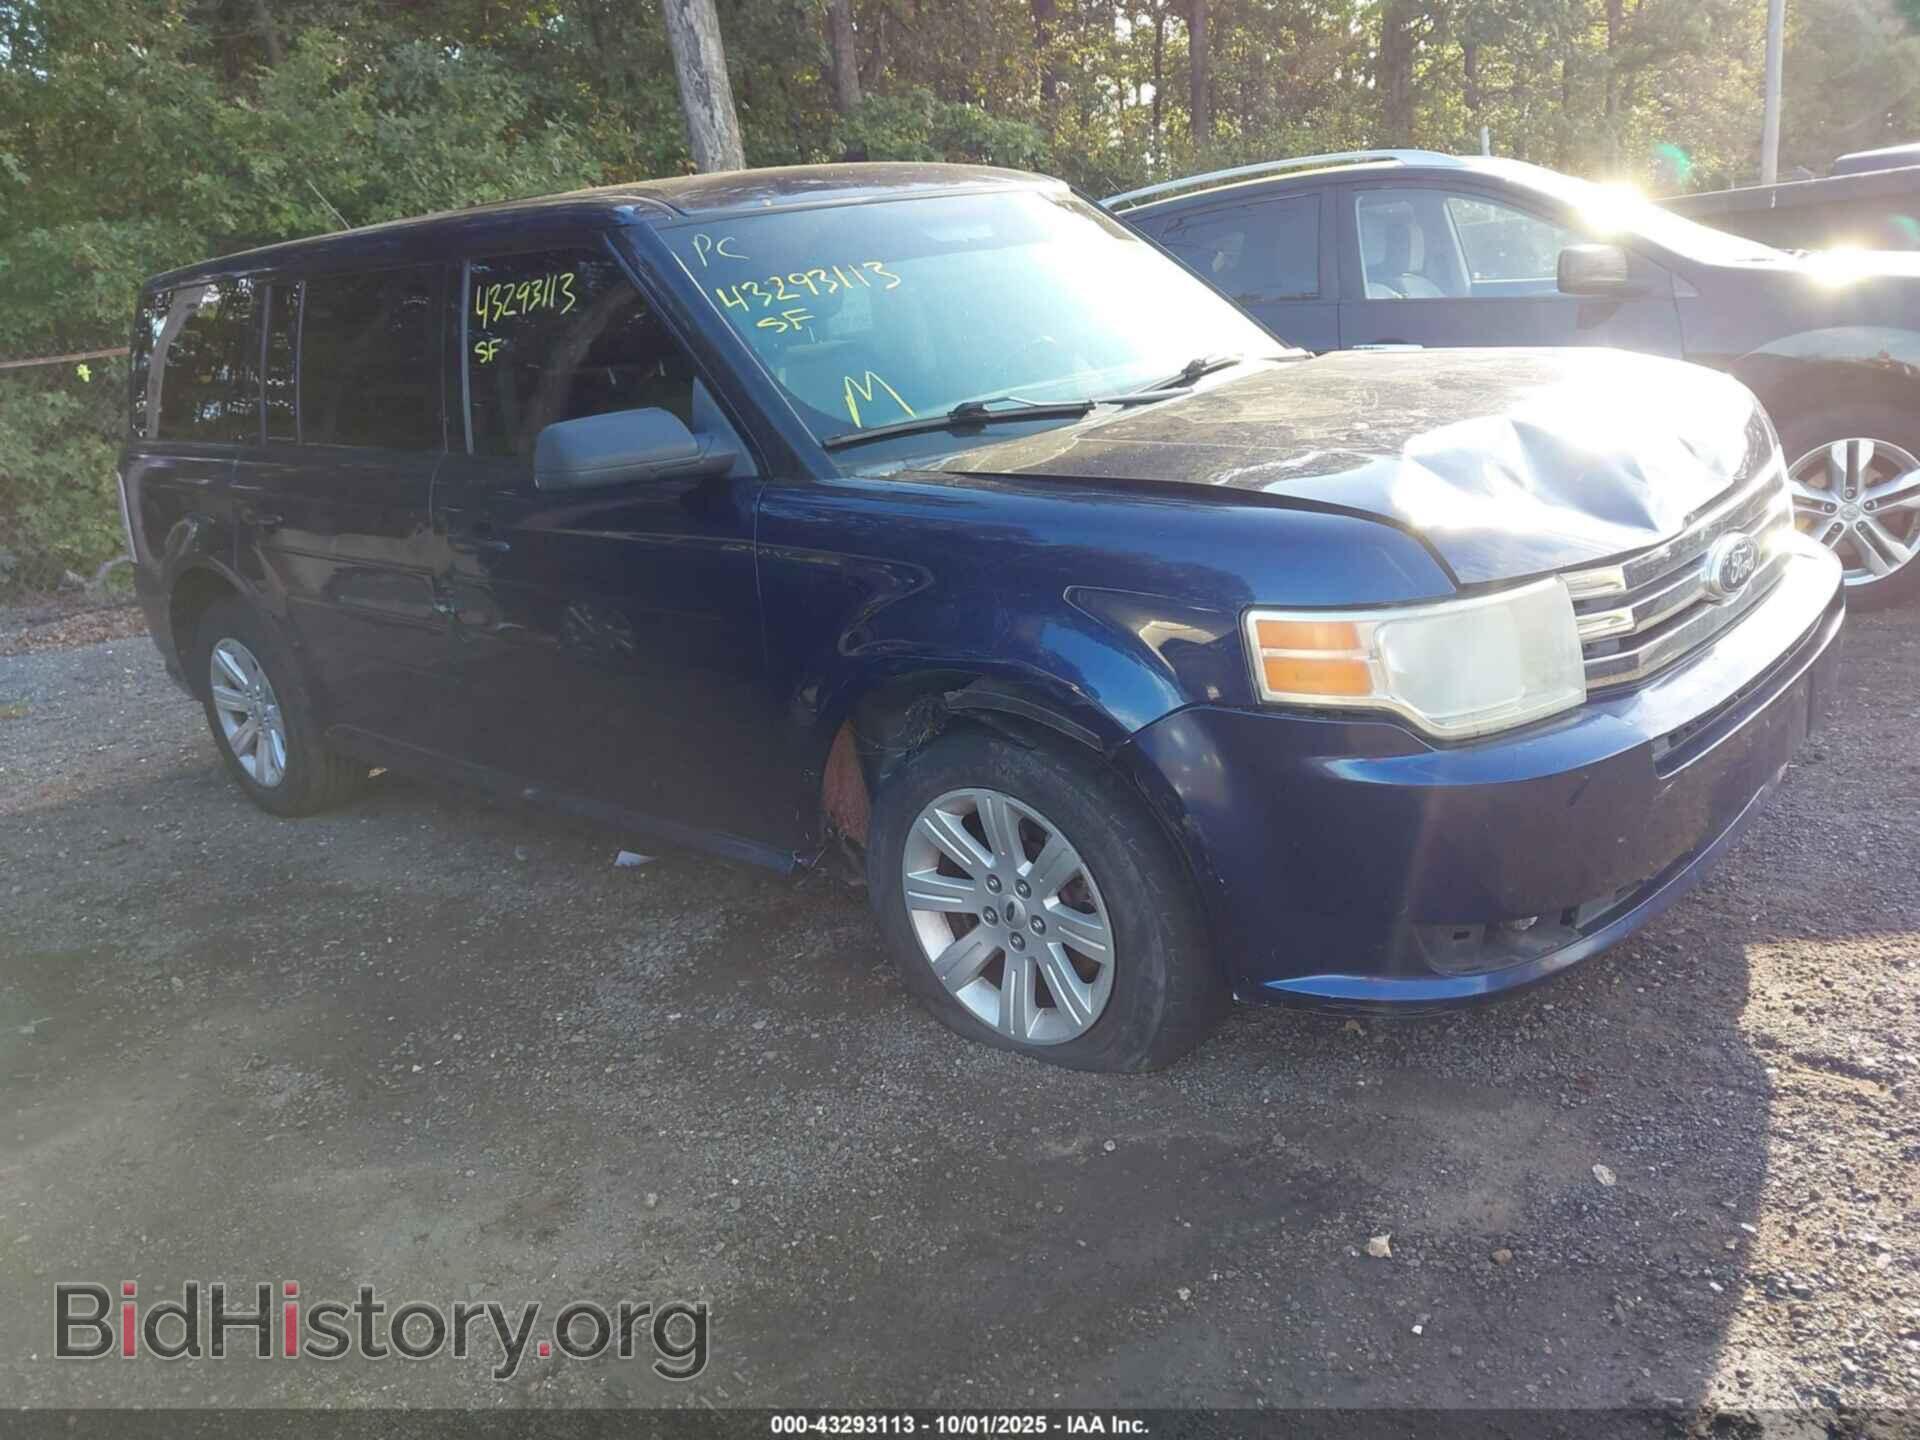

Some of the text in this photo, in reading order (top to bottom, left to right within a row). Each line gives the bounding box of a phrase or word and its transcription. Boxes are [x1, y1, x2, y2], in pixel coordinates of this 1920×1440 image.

[692, 233, 750, 268] PC
[475, 272, 577, 329] 43293113
[716, 260, 901, 312] 43293113
[756, 307, 815, 333] SF
[474, 338, 503, 364] SF
[844, 370, 917, 428] M
